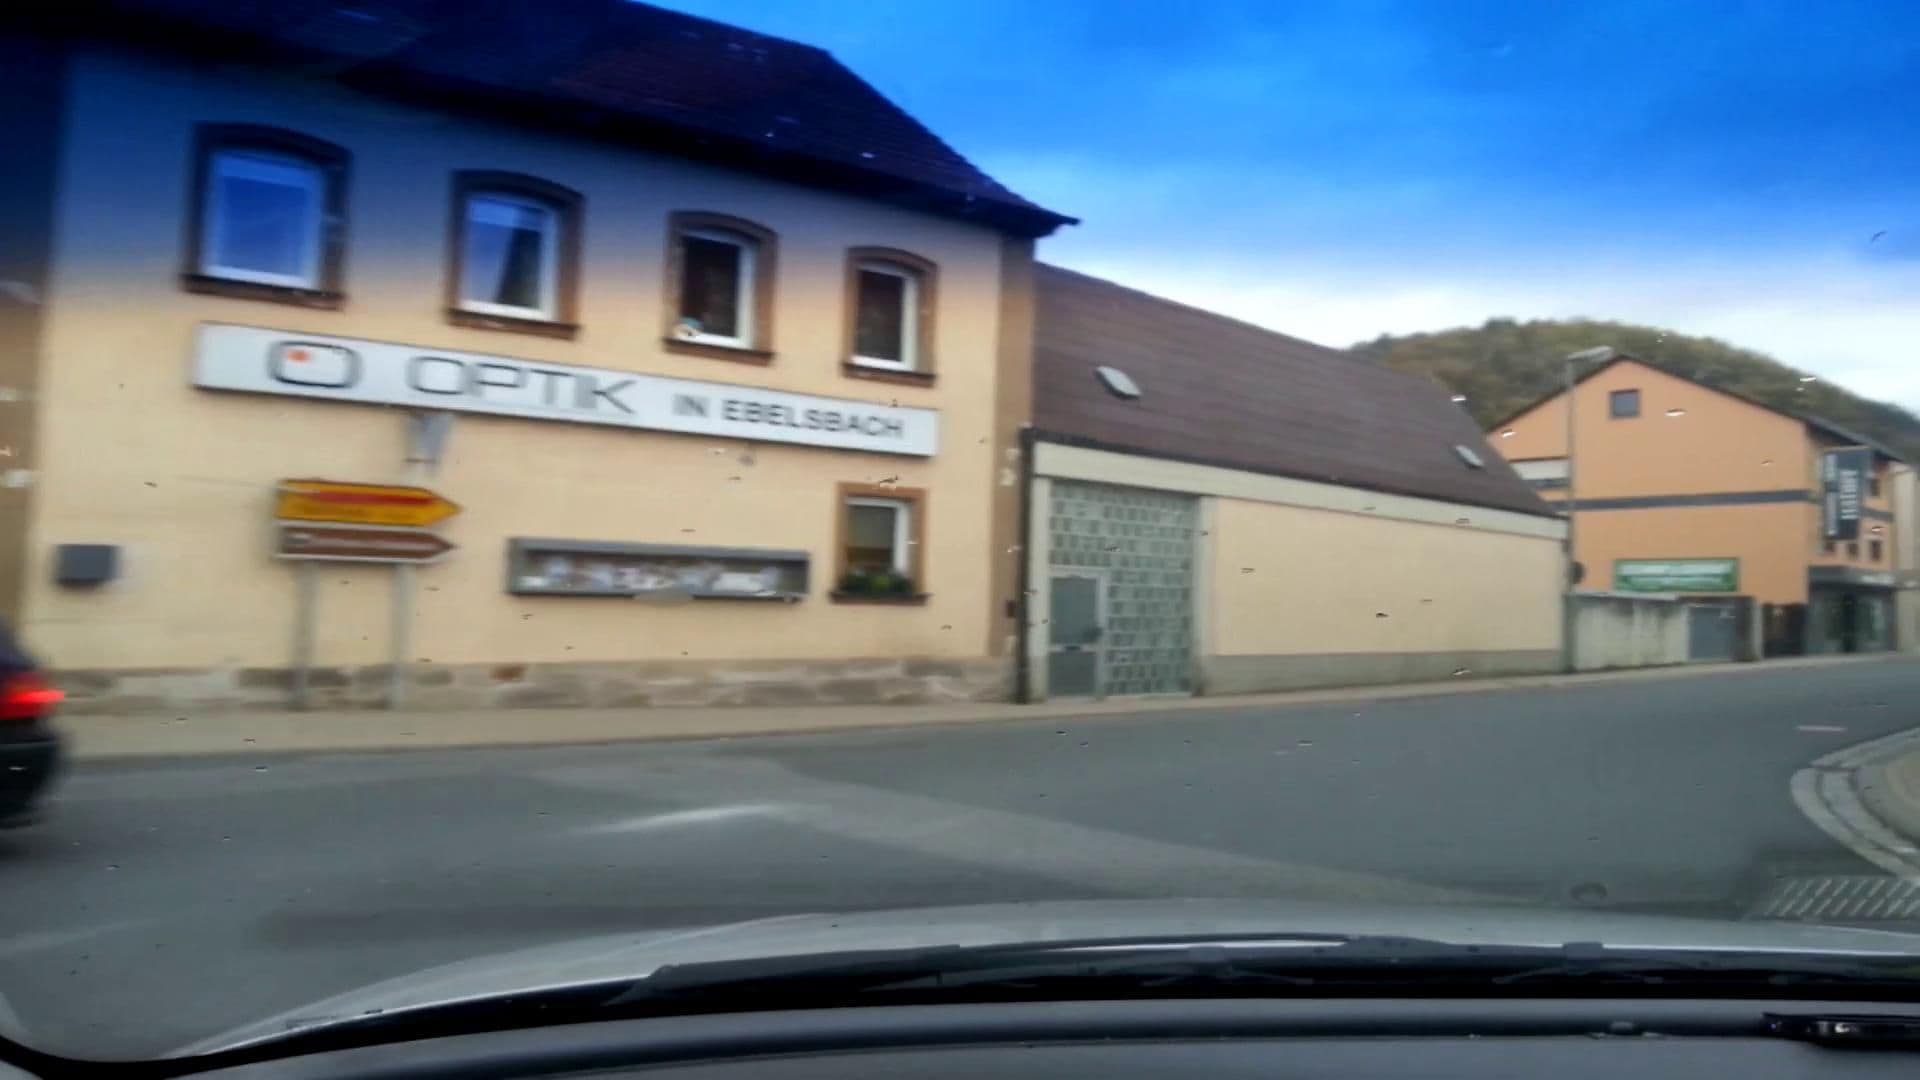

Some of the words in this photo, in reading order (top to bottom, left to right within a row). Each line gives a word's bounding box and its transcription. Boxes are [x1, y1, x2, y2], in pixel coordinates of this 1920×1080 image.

[408, 355, 637, 415] OPTIK
[674, 393, 708, 418] IN
[723, 400, 905, 438] EBELSBACH
